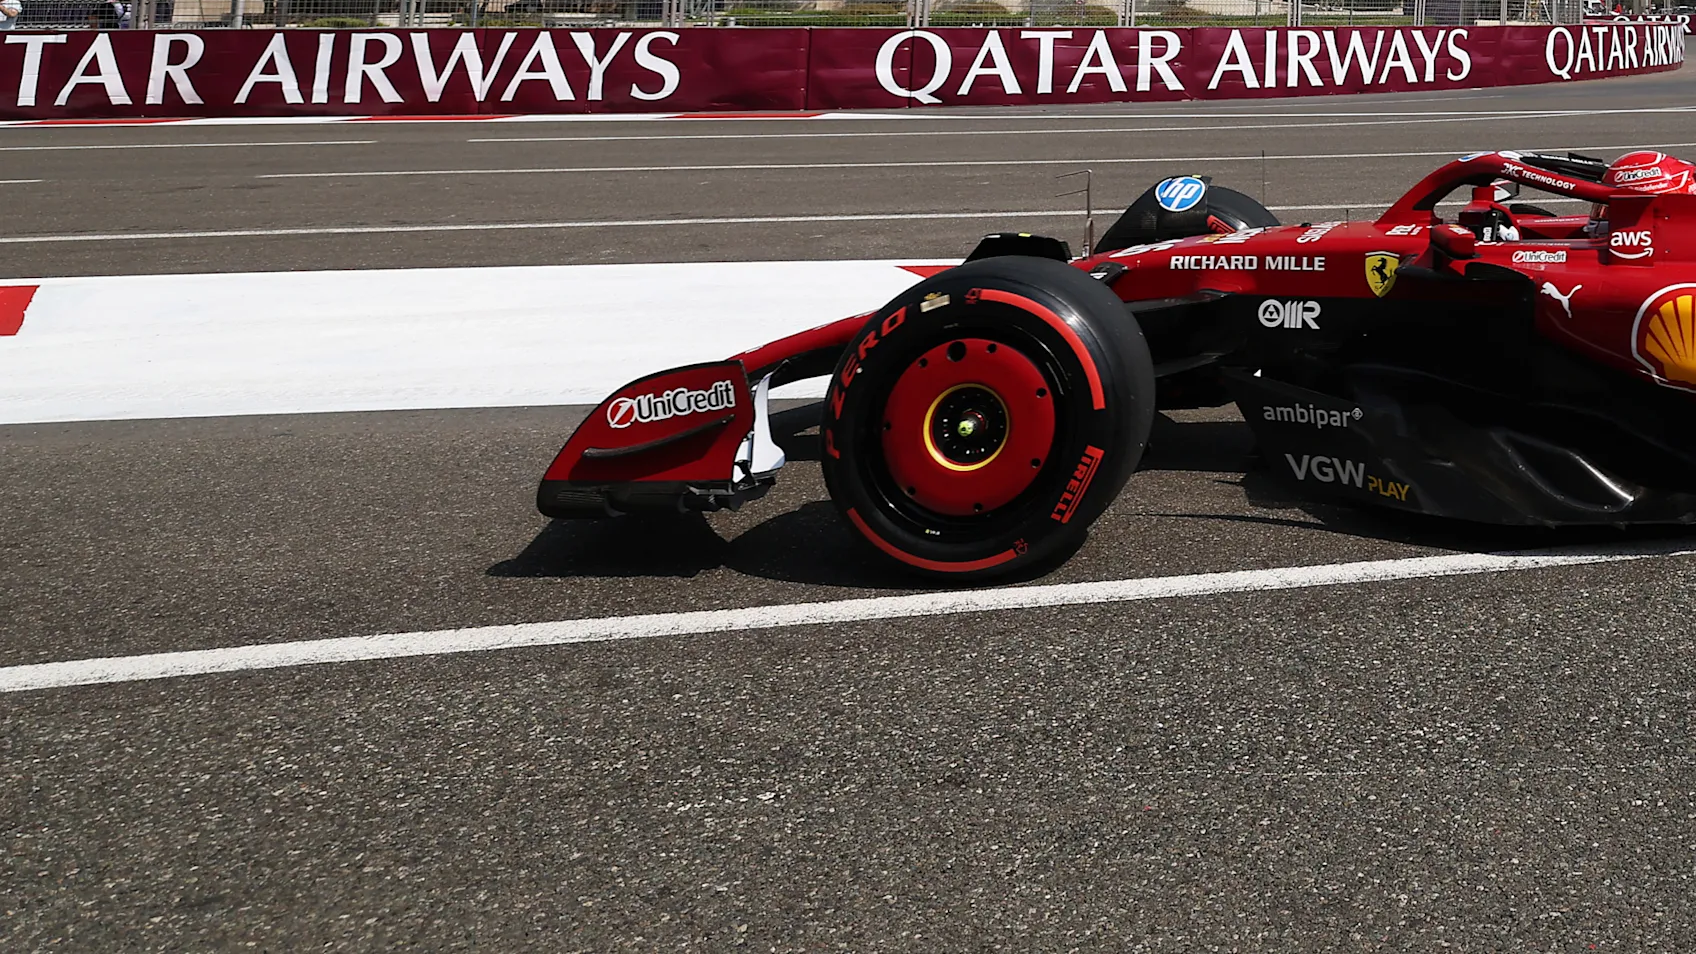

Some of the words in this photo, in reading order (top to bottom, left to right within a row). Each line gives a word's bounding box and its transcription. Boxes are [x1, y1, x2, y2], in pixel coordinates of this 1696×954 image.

[234, 31, 681, 105] AIRWAYS
[875, 29, 1184, 104] QATAR
[1208, 28, 1472, 91] AIRWAYS
[1545, 25, 1639, 80] QATAR
[1521, 170, 1576, 190] TECHNOLOGY
[1622, 168, 1662, 182] UniCredit
[1158, 176, 1204, 212] hp
[1611, 230, 1652, 247] aws
[1170, 255, 1258, 271] RICHARD
[1265, 256, 1326, 272] MILLE
[1524, 251, 1566, 263] UniCredit
[830, 305, 908, 422] ZERO
[635, 379, 736, 422] UniCredit
[1263, 403, 1351, 429] ambipar
[826, 429, 841, 459] P
[1050, 443, 1105, 525] PIRELLI
[1284, 452, 1366, 489] VGW
[1367, 475, 1411, 502] PLAY
